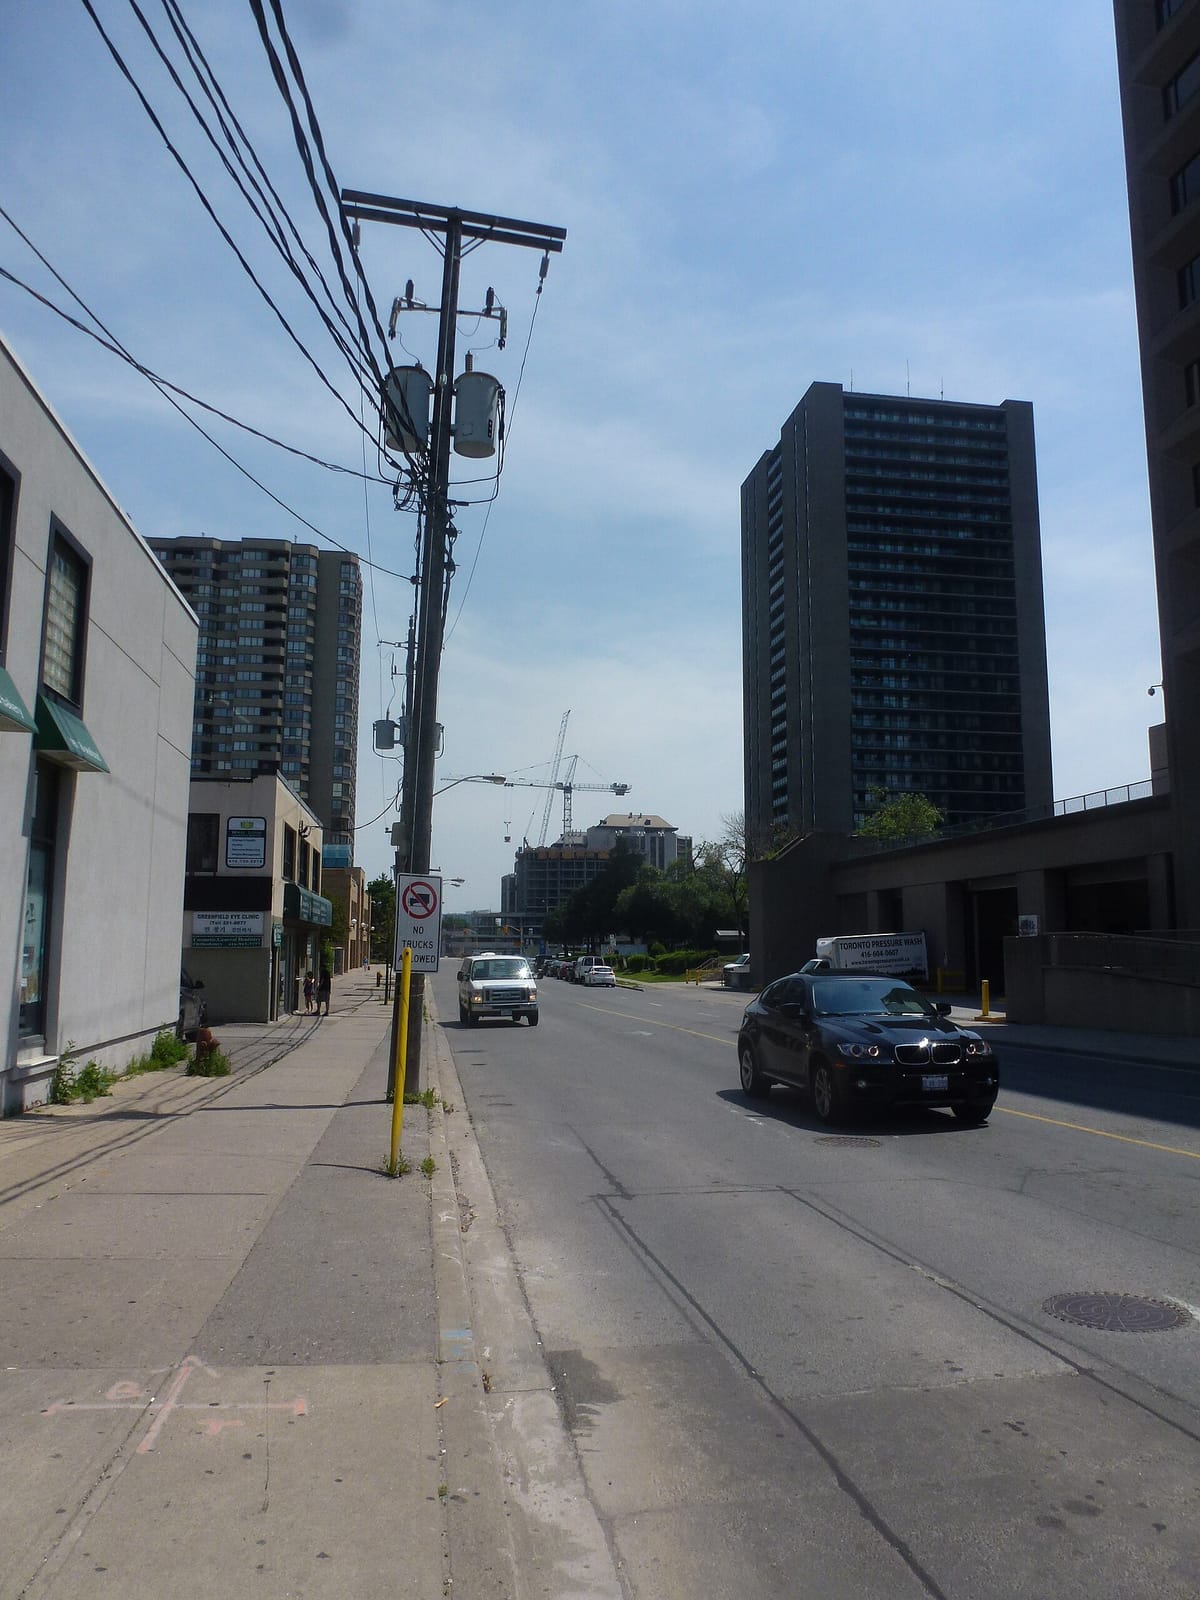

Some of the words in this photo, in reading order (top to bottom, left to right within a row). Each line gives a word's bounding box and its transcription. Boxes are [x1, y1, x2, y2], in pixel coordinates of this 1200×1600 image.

[412, 926, 424, 935] NO
[402, 940, 434, 949] TRUCKS
[839, 940, 871, 950] TORONTO
[872, 938, 903, 948] PRESSURE
[903, 937, 922, 946] WASH
[398, 954, 436, 964] AOWED
